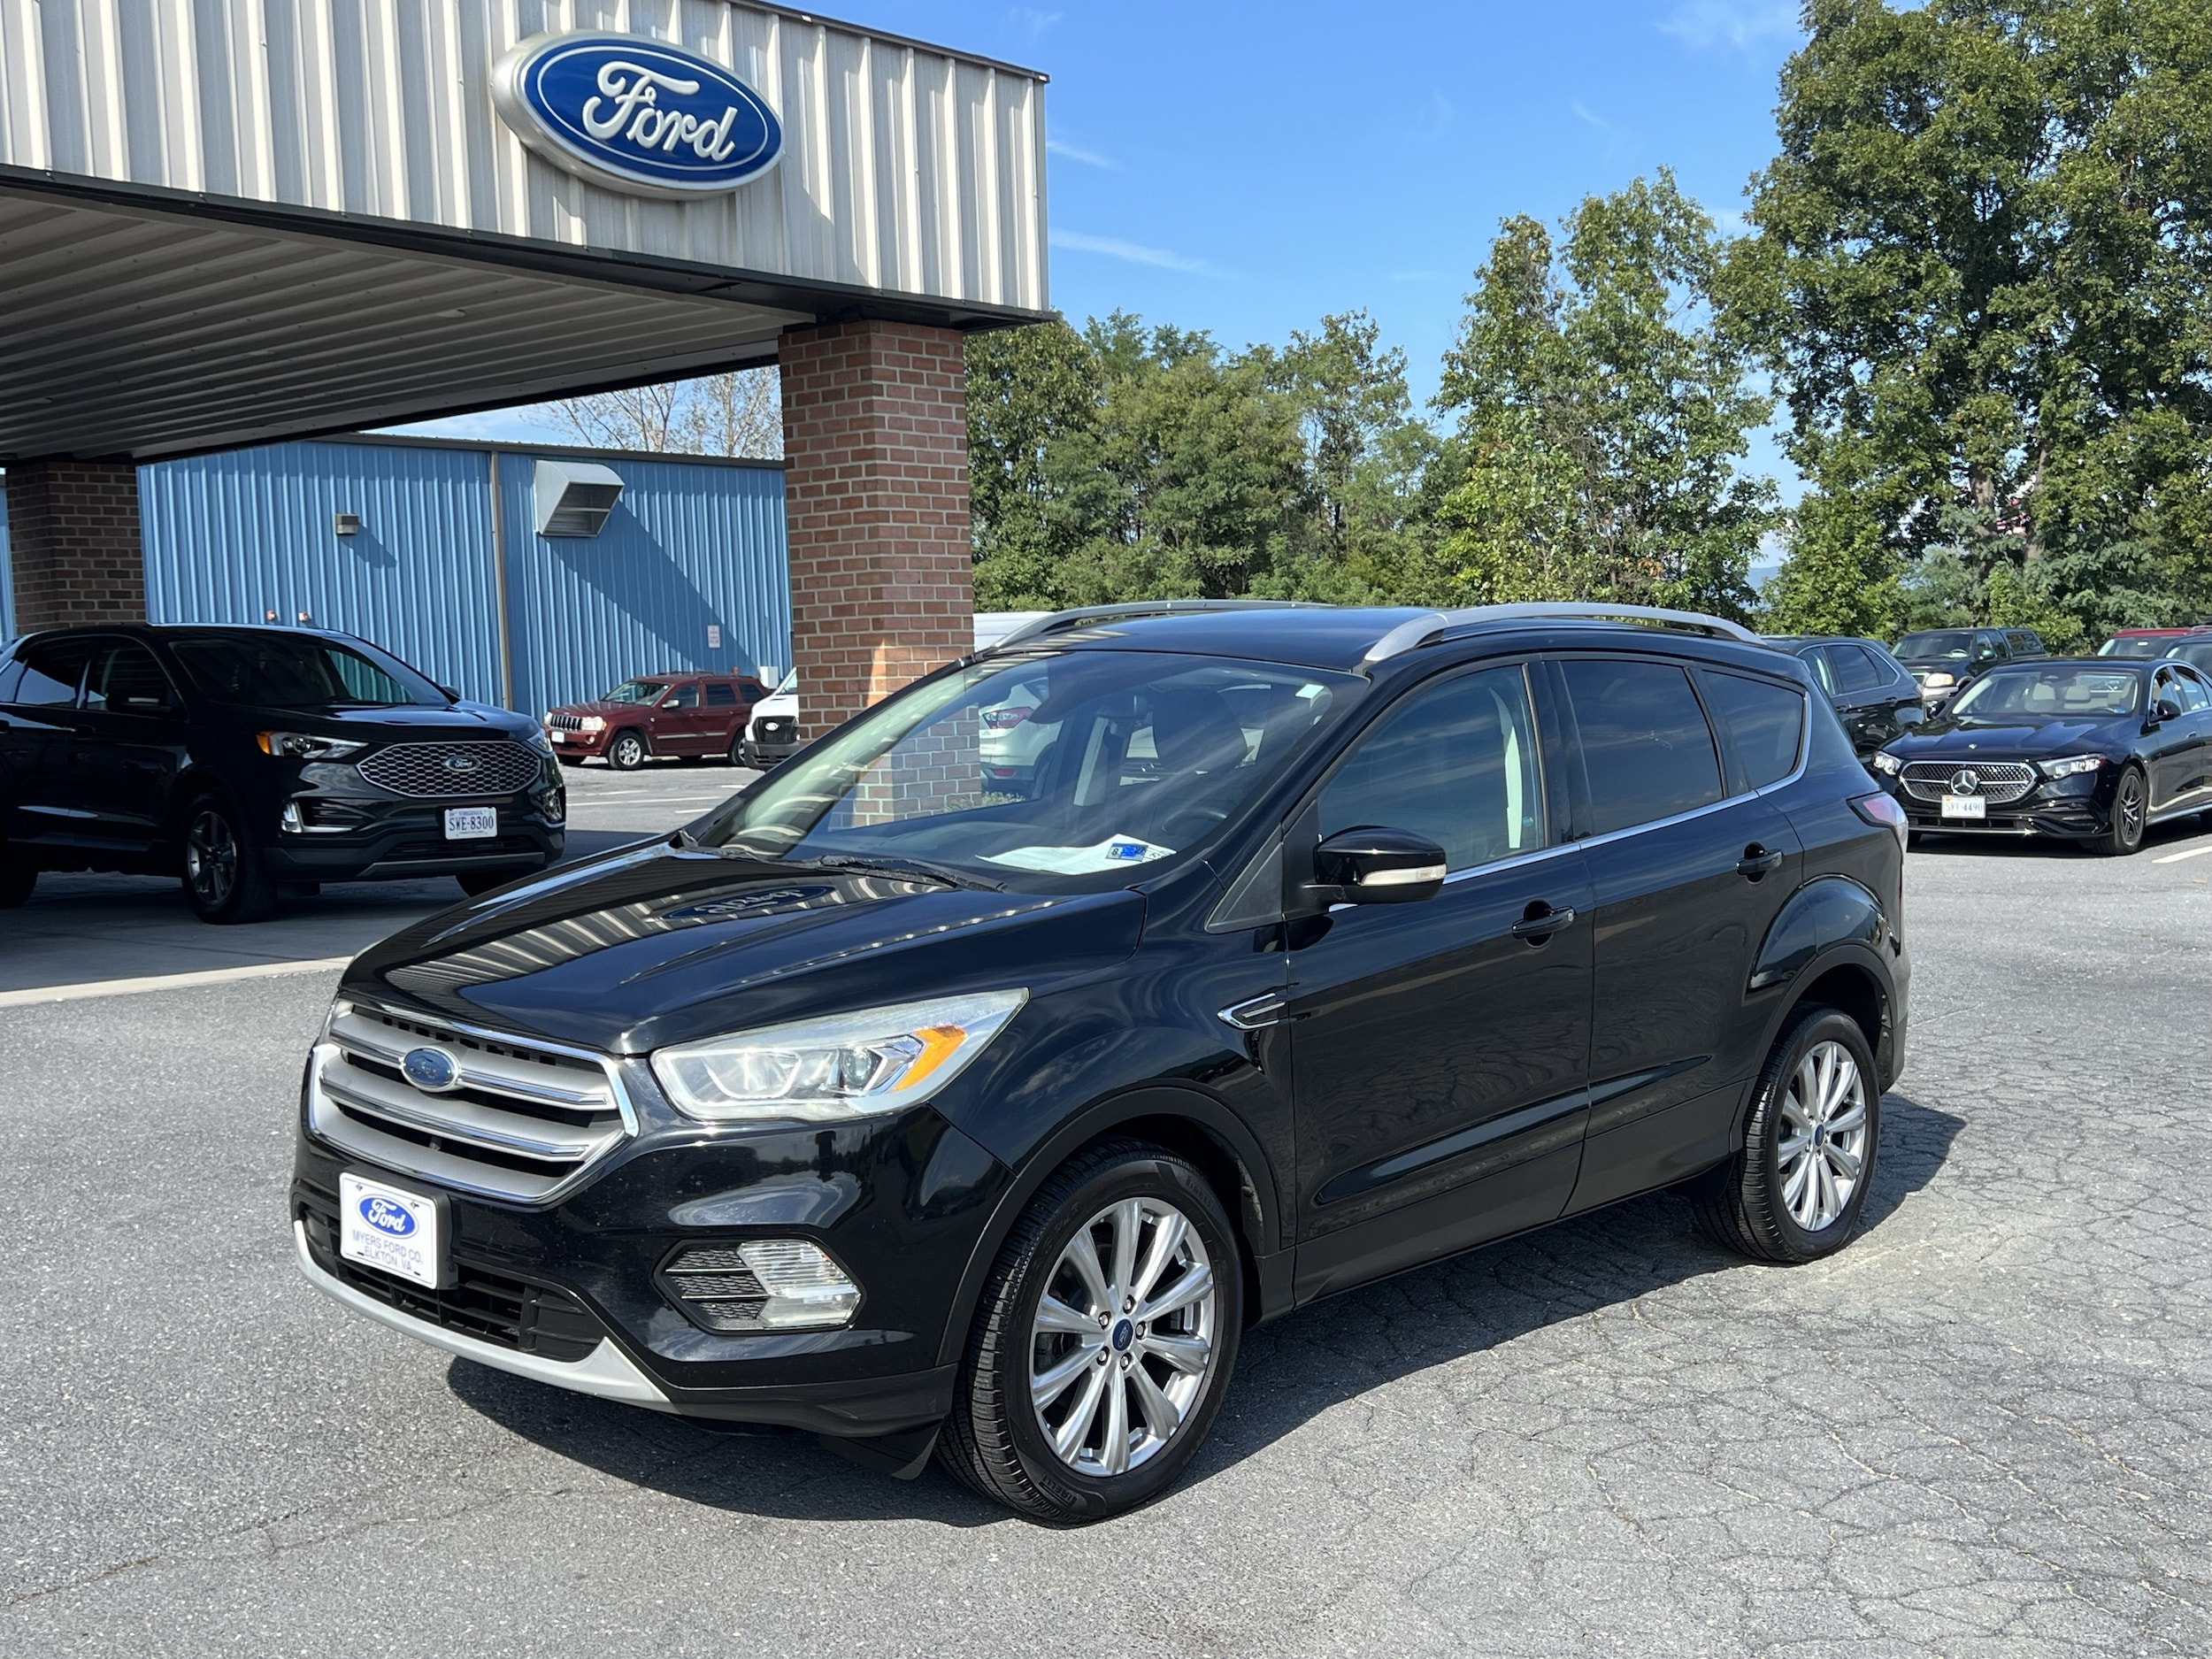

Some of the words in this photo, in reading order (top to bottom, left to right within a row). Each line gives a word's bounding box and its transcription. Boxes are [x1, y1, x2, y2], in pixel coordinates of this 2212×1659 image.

[582, 60, 738, 162] Ford
[449, 816, 494, 831] SWE-8300
[368, 1198, 407, 1233] Ford
[352, 1229, 382, 1248] MYERS
[383, 1240, 407, 1257] FORD
